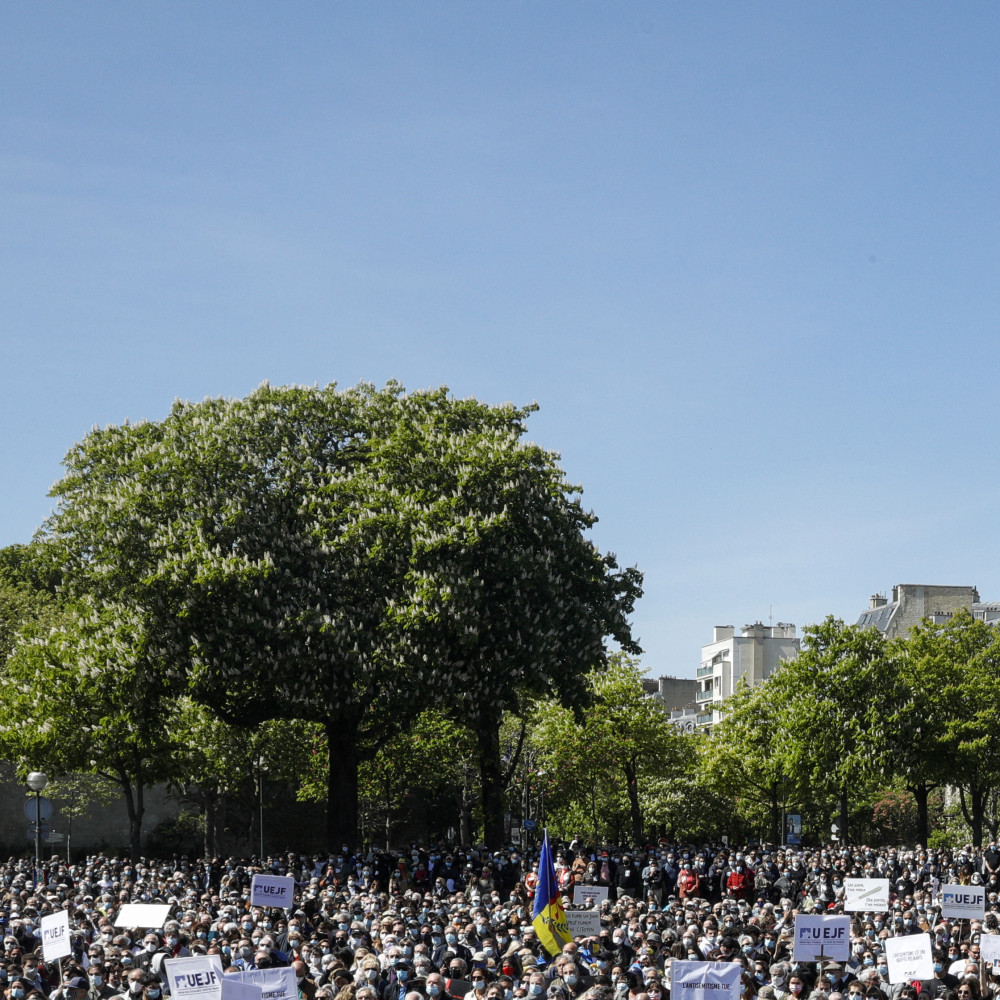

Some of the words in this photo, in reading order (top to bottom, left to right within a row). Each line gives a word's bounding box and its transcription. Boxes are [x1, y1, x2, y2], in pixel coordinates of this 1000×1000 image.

[263, 885, 287, 895] UEJF
[955, 894, 984, 905] UEJF
[49, 925, 65, 939] UEJF
[813, 927, 845, 939] UEJF
[187, 971, 217, 988] UEJF
